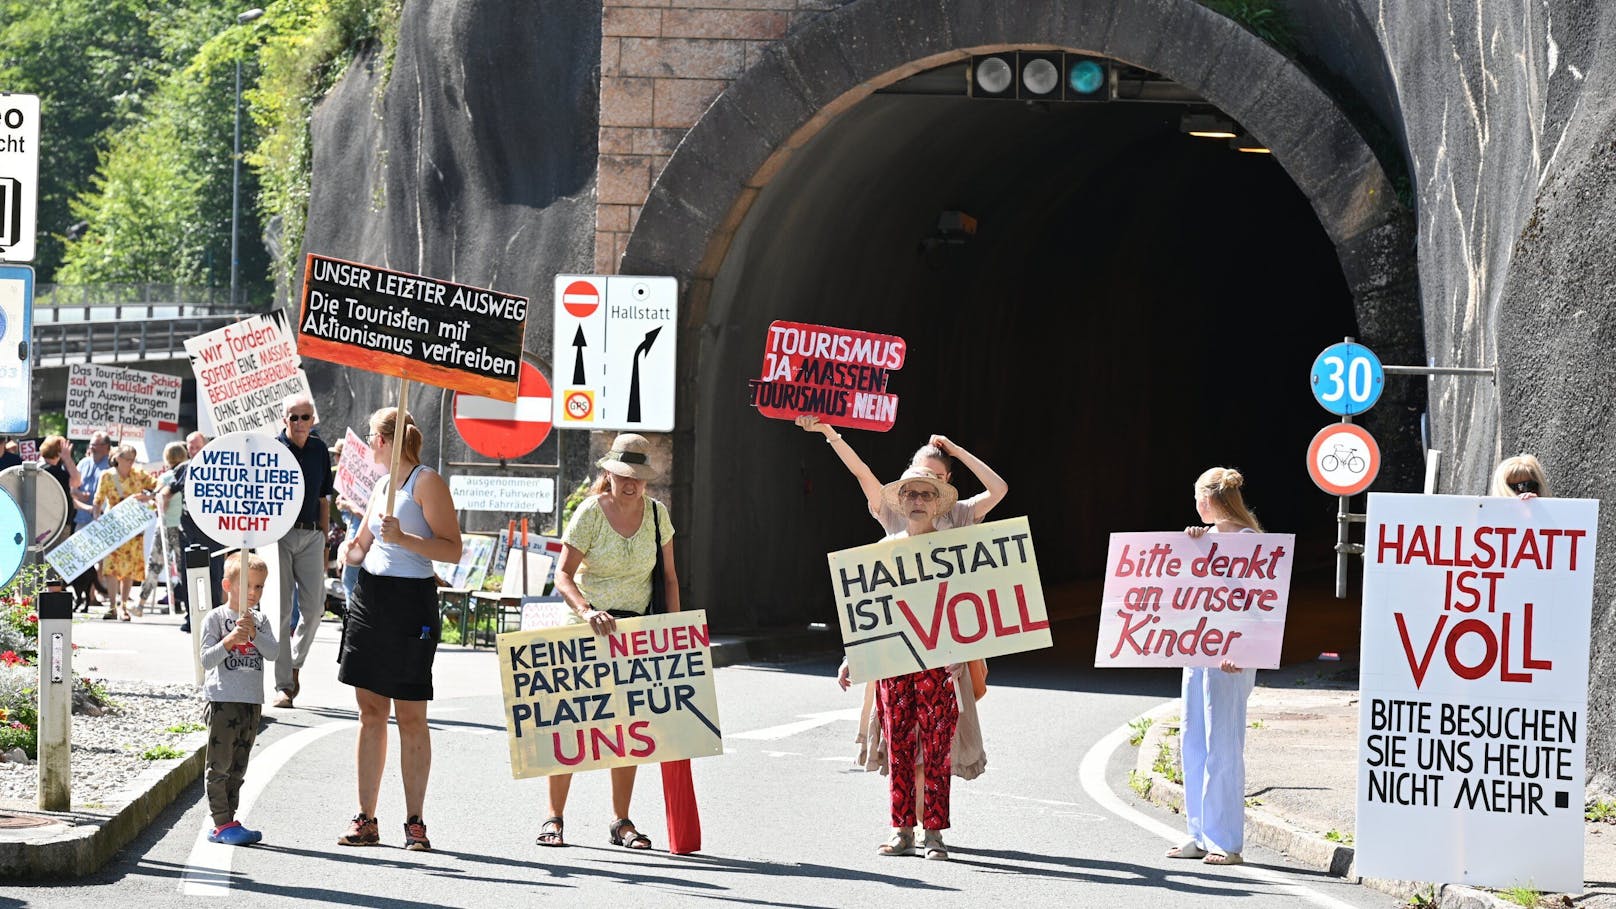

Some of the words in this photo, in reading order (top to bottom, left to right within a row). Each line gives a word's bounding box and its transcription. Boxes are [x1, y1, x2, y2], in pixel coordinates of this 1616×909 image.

[0, 109, 24, 129] o
[313, 259, 371, 290] UNSER
[375, 273, 446, 306] LETZTER
[450, 287, 526, 321] AUSWEG
[310, 290, 339, 315] Die
[345, 298, 429, 334] Touristen
[438, 320, 471, 342] mit
[611, 305, 671, 320] Hallstatt
[199, 338, 222, 364] wir
[224, 321, 276, 360] fordern
[302, 311, 413, 355] Aktionismus
[422, 342, 516, 375] vertreiben
[771, 326, 903, 369] TOURISMUS
[72, 364, 92, 376] Das
[96, 367, 147, 383] Touristische
[201, 361, 237, 387] SOFORT
[237, 354, 258, 374] EINE
[259, 342, 292, 367] MASSIVE
[208, 360, 297, 404] BESUCHERBEGRENZUNG
[762, 353, 792, 382] JA
[1321, 356, 1372, 403] 30
[69, 398, 86, 409] auf
[90, 401, 125, 413] andere
[129, 404, 176, 420] Regionen
[70, 376, 87, 386] sal
[90, 380, 108, 389] von
[111, 379, 154, 395] Hallstatt
[156, 388, 177, 399] wird
[70, 388, 94, 399] auch
[98, 390, 168, 409] Auswirkungen
[214, 400, 241, 422] OHNE
[240, 376, 304, 412] UMSCHICHTUNGEN
[852, 392, 899, 423] NEIN
[68, 409, 88, 419] und
[92, 410, 114, 422] Orte
[119, 414, 152, 427] haben
[240, 411, 263, 431] OHNE
[190, 466, 249, 482] KULTUR
[255, 469, 299, 484] LIEBE
[203, 450, 245, 466] WEIL
[251, 452, 278, 468] ICH
[194, 483, 264, 499] BESUCHE
[269, 485, 293, 500] ICH
[201, 499, 284, 516] HALLSTATT
[218, 516, 270, 531] NICHT
[840, 533, 1028, 598] HALLSTATT
[1115, 544, 1181, 578] bitte
[1191, 542, 1286, 580] denkt
[1377, 523, 1586, 571] HALLSTATT
[1124, 586, 1163, 612] an
[1172, 586, 1278, 612] unsere
[1444, 570, 1505, 613] IST
[846, 595, 893, 633] IST
[896, 581, 1050, 651] VOLL
[1110, 609, 1242, 659] Kinder
[510, 637, 597, 671] KEINE
[608, 623, 710, 659] NEUEN
[1394, 602, 1552, 691] VOLL
[513, 651, 706, 698] PARKPLÄTZE
[512, 693, 615, 738] PLATZ
[627, 682, 722, 740] FÜR
[1371, 698, 1432, 734] BITTE
[1440, 703, 1577, 743] BESUCHEN
[552, 721, 656, 766] UNS
[1366, 734, 1407, 768] SIE
[1417, 738, 1474, 773] UNS
[1484, 742, 1573, 781] HEUTE
[1368, 769, 1444, 807] NICHT
